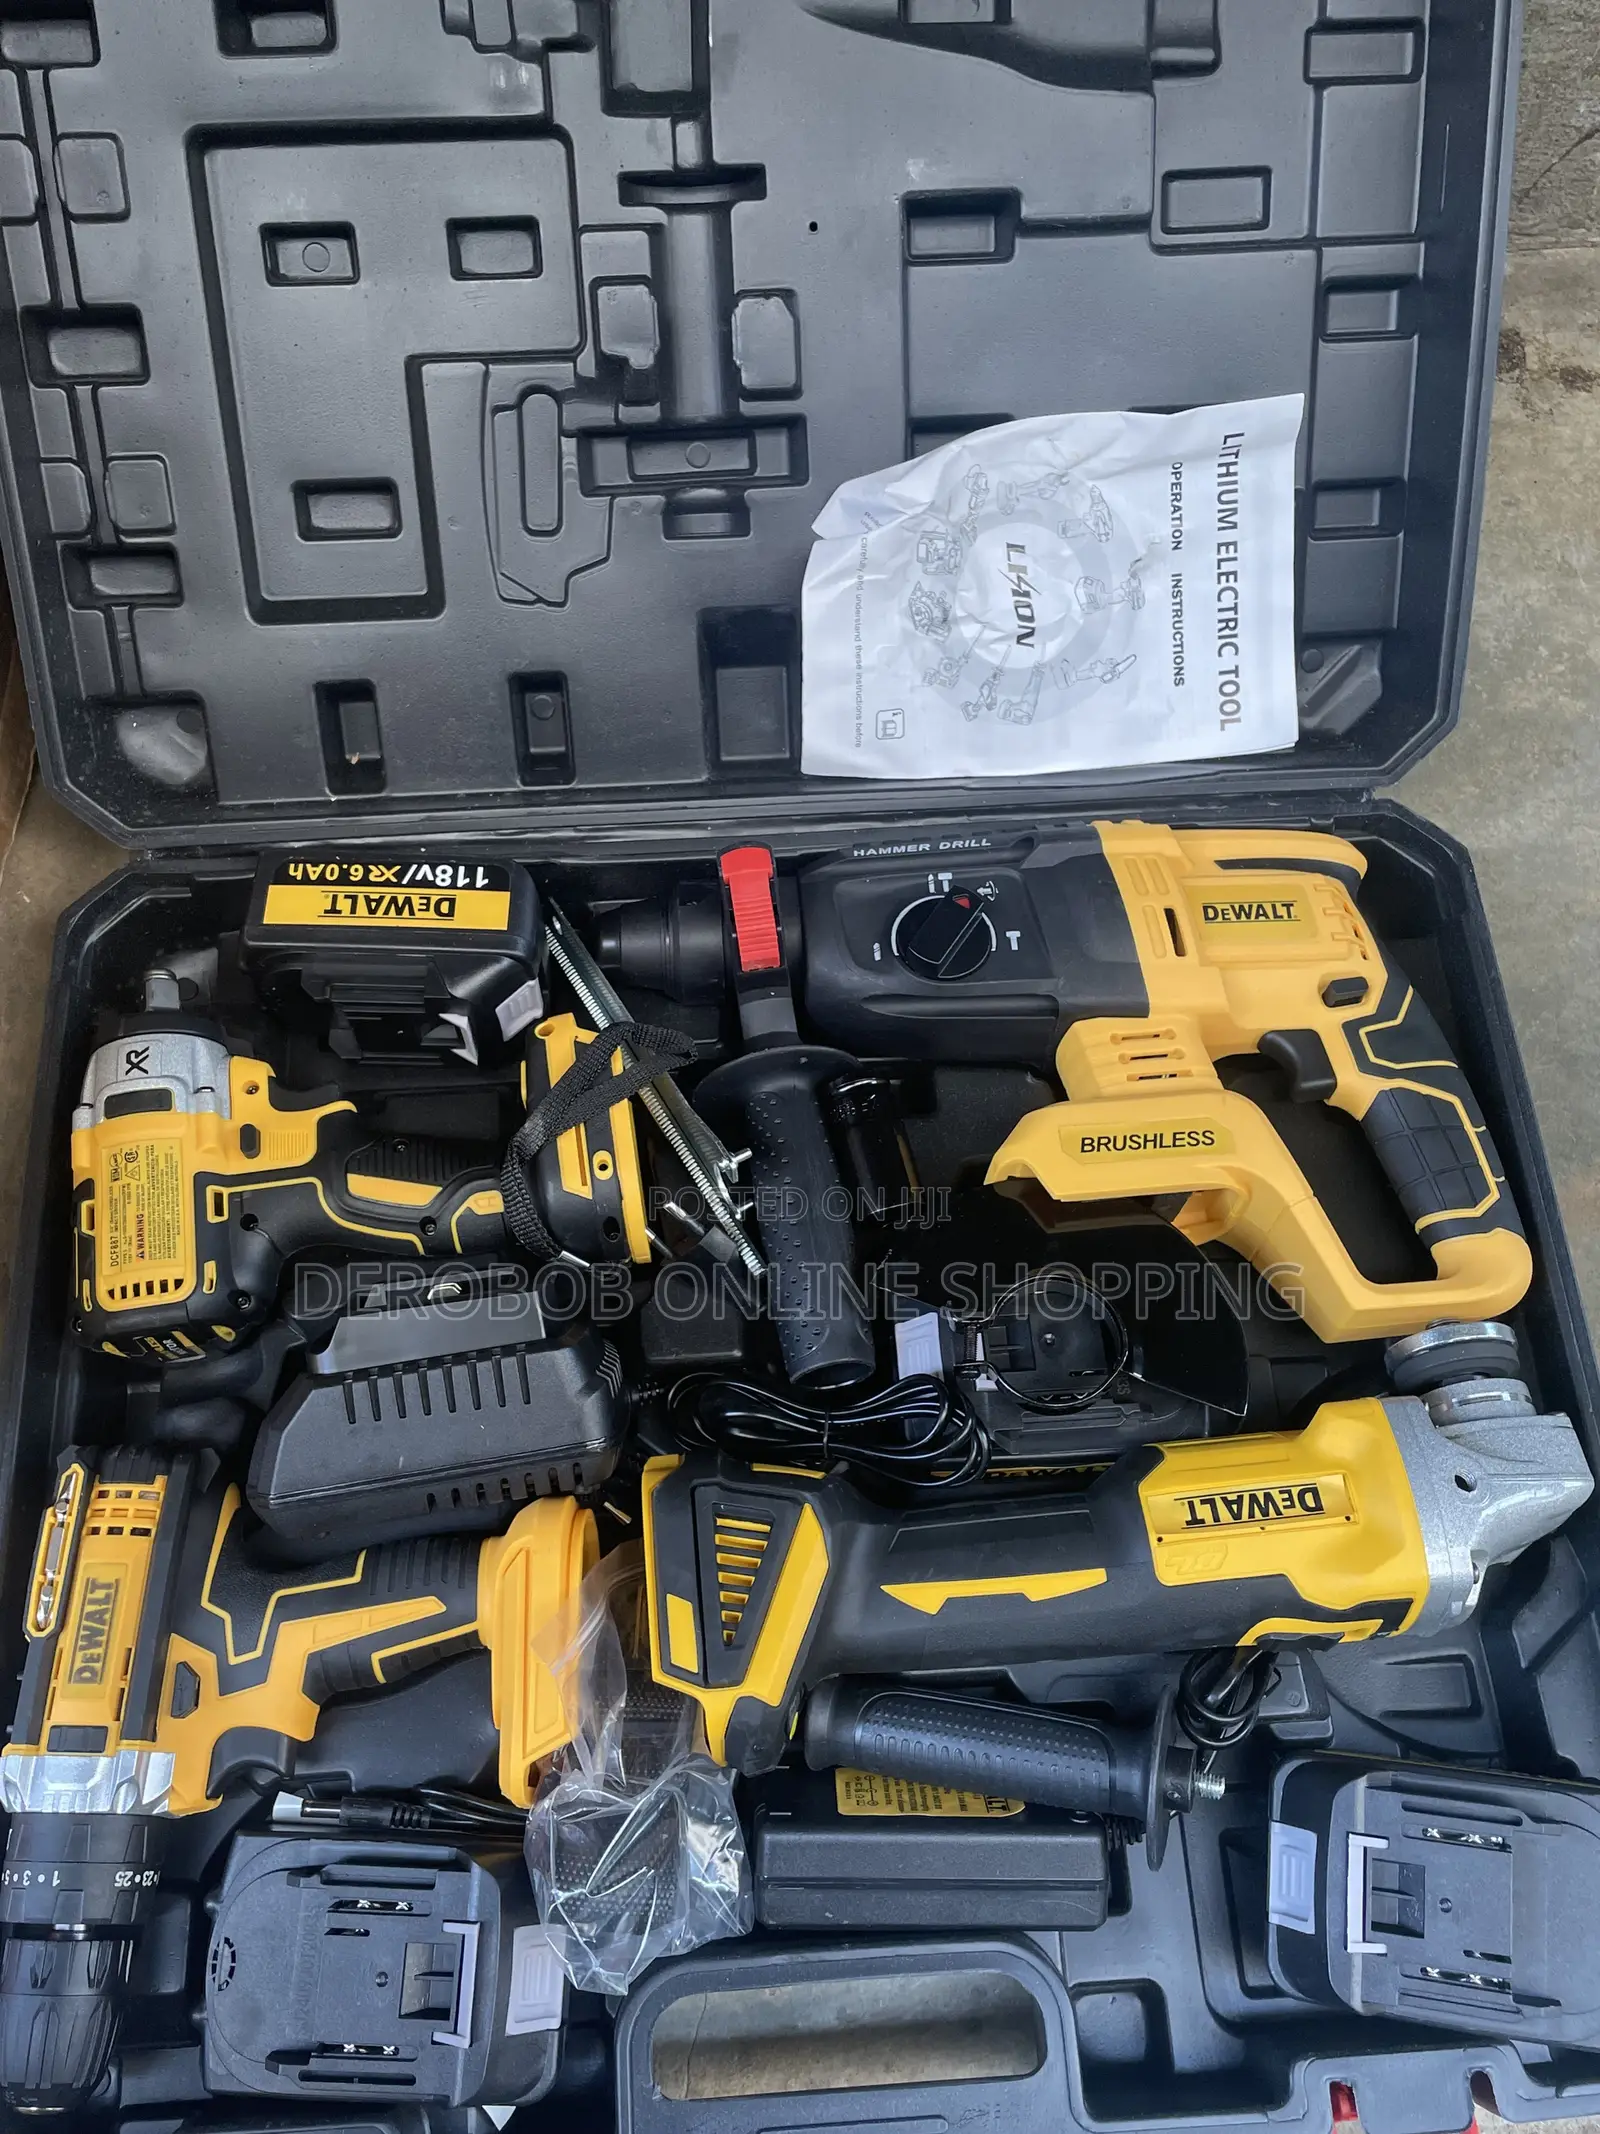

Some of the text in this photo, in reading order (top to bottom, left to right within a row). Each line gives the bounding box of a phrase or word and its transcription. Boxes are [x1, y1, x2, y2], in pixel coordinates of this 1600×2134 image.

[856, 537, 868, 573] carefully
[856, 575, 866, 590] and
[1170, 462, 1185, 688] OPERATION INSTRUCTIONS
[1216, 432, 1246, 732] LITHIUM ELECTRIC TOOL
[854, 594, 864, 642] understand
[854, 645, 864, 669] these
[855, 673, 864, 720] instructions
[854, 723, 864, 748] before
[853, 838, 992, 857] HAMMER DRILL
[1080, 1130, 1215, 1153] BRUSHLESS
[136, 1213, 145, 1251] WARNING
[110, 1235, 120, 1267] DCF887
[114, 1870, 134, 1887] 25
